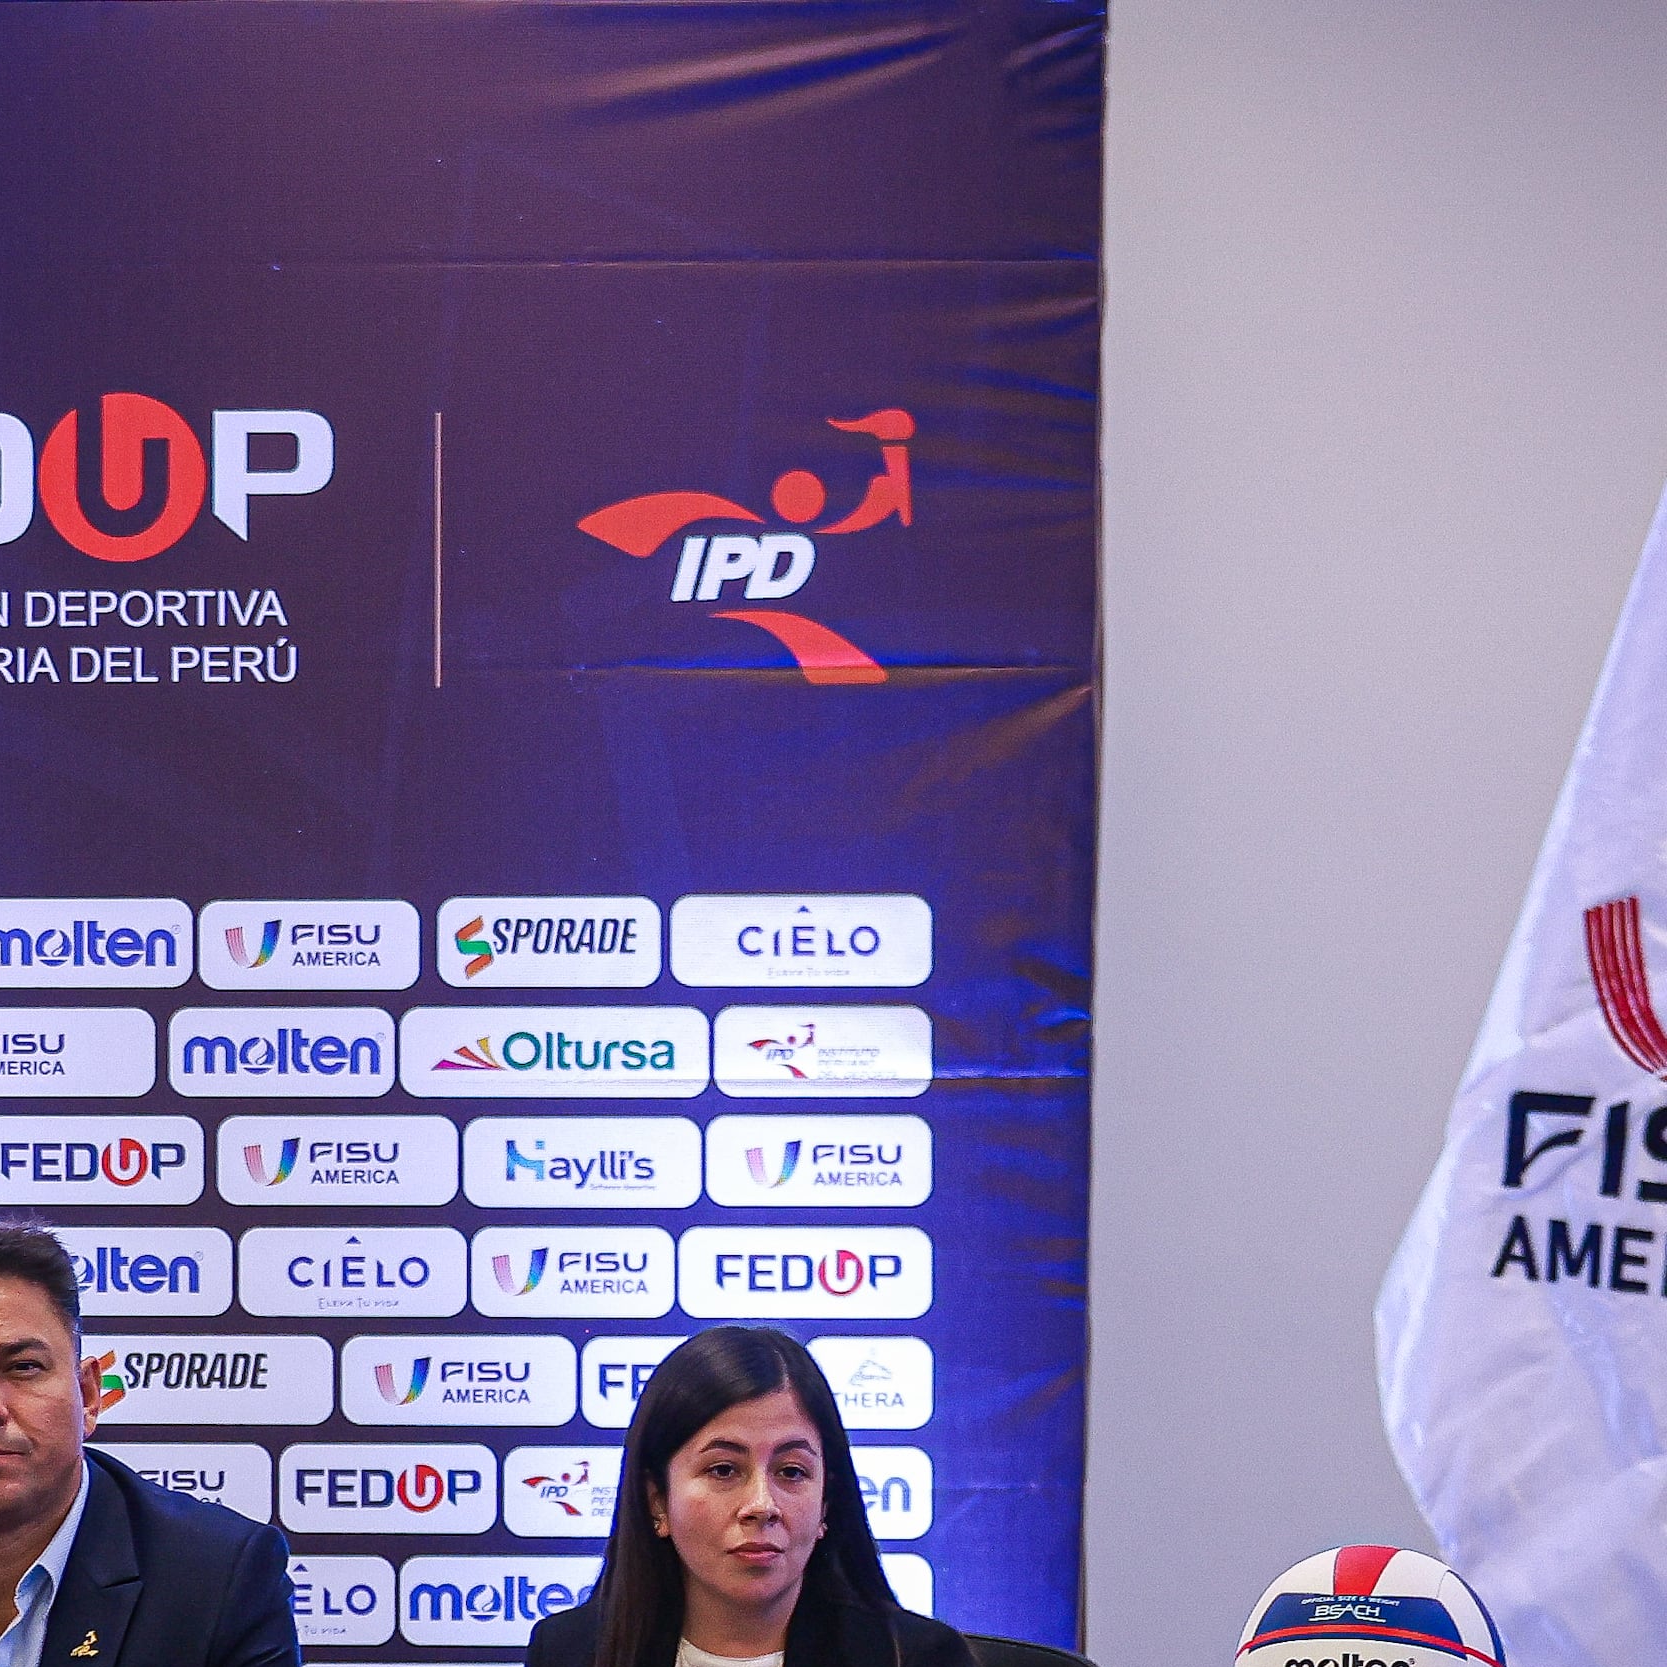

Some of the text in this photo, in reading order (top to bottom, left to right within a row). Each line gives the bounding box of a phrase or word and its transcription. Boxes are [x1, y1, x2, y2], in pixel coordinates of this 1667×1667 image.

[672, 533, 817, 602] IPD
[24, 588, 288, 628] DEPORTIVA
[69, 645, 159, 683] DEL
[171, 637, 299, 683] PERÚ
[291, 925, 380, 945] FISU
[493, 918, 636, 954] SPORADE
[292, 952, 380, 966] AMERICA
[183, 1028, 380, 1075] molten
[502, 1032, 675, 1071] Oltursa
[310, 1142, 399, 1163] FISU
[813, 1145, 901, 1164] FISU
[311, 1169, 399, 1184] AMERICA
[814, 1172, 902, 1186] AMERICA
[559, 1253, 647, 1272] FISU
[560, 1279, 647, 1293] AMERICA
[124, 1353, 268, 1389] SPORADE
[441, 1362, 530, 1382] FISU
[442, 1389, 530, 1403] AMERICA
